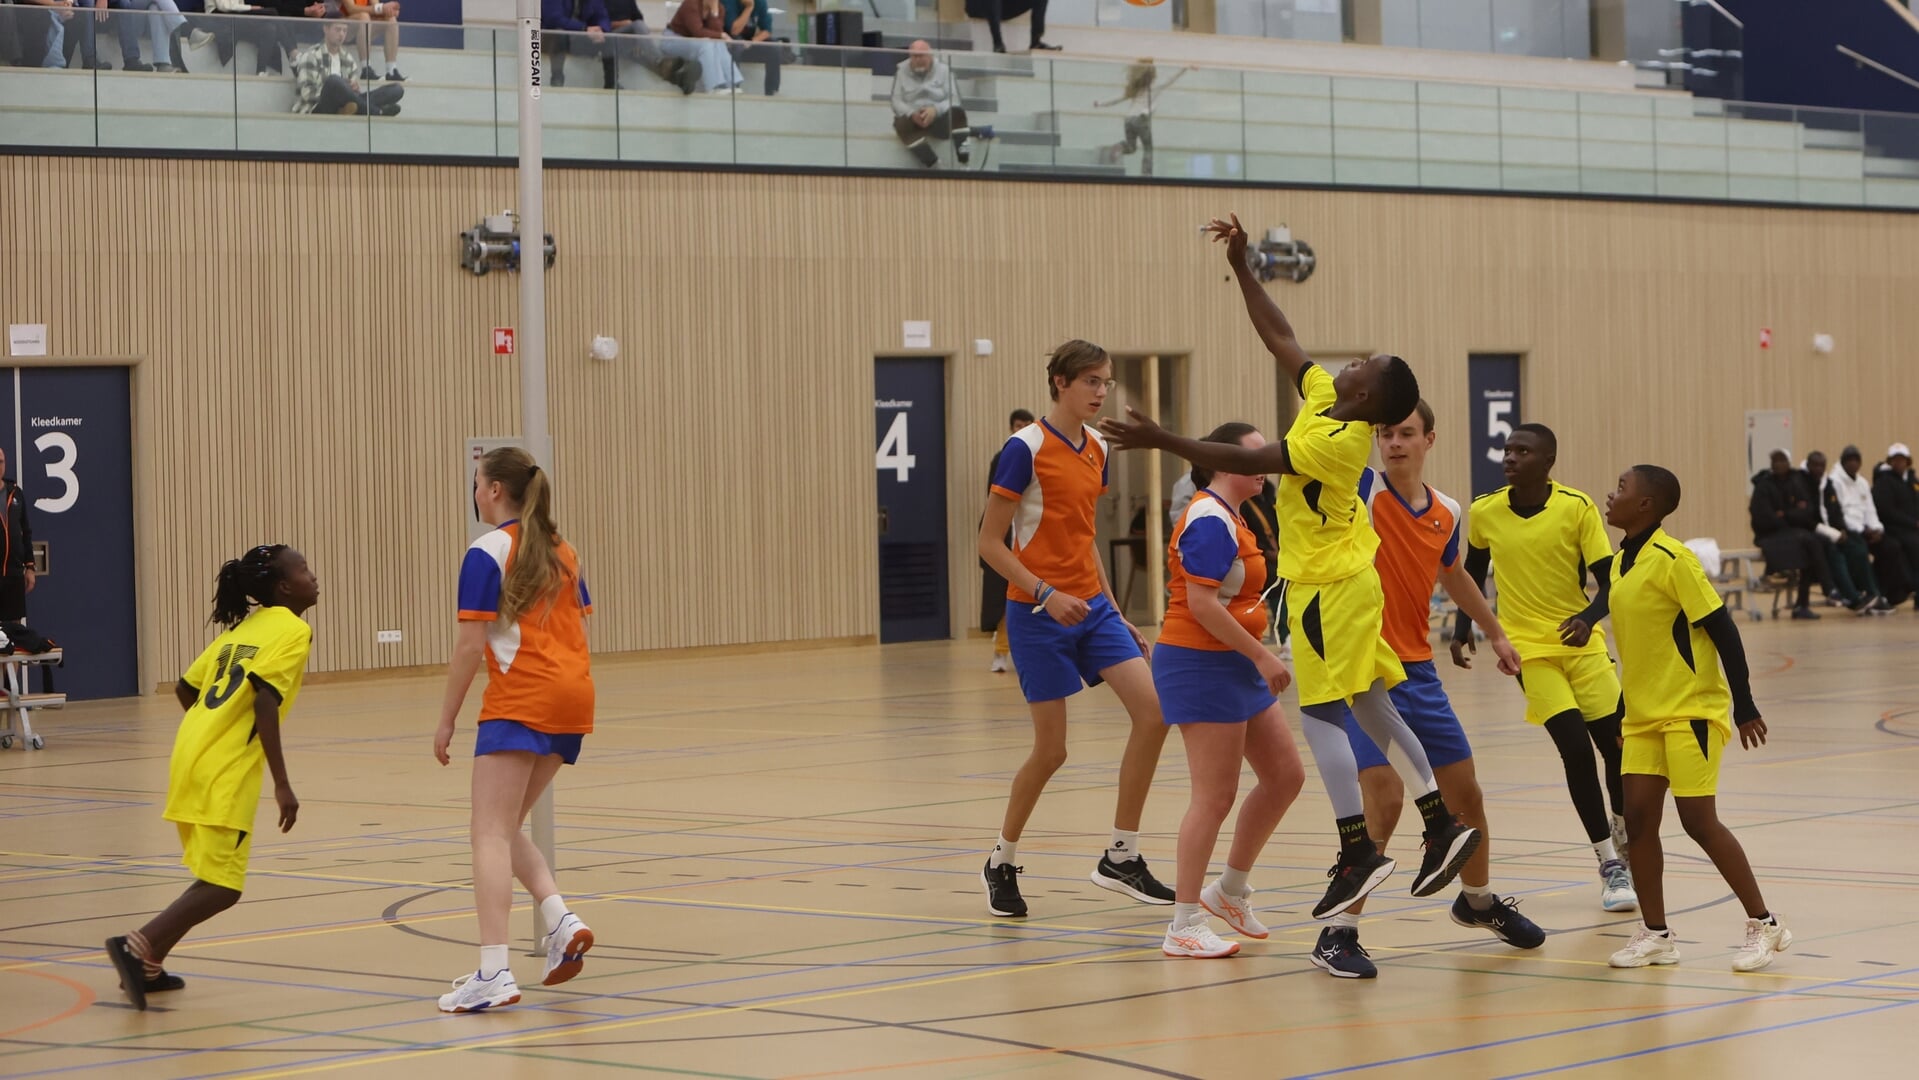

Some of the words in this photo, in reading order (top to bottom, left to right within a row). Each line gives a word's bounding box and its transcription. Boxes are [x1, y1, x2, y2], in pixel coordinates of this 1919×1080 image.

[531, 41, 540, 86] BOSAN
[31, 416, 82, 427] Kleedkamer
[876, 412, 916, 482] 4
[1486, 400, 1513, 463] 5
[34, 431, 80, 513] 3
[204, 643, 260, 710] 15
